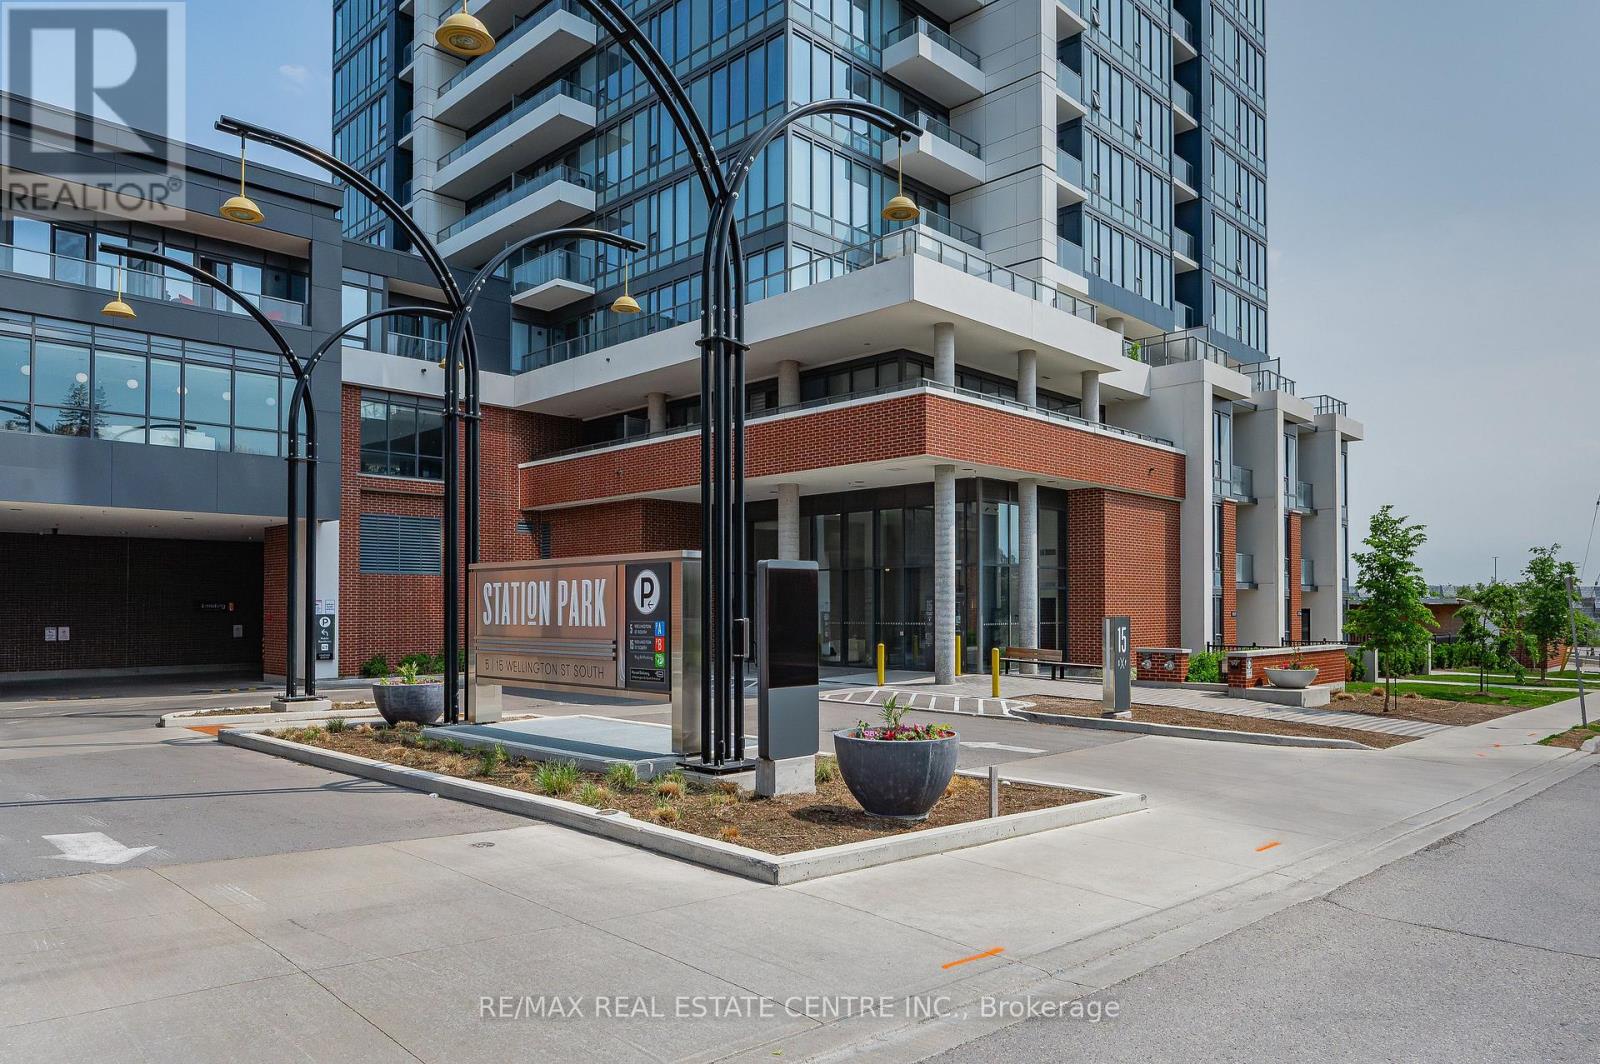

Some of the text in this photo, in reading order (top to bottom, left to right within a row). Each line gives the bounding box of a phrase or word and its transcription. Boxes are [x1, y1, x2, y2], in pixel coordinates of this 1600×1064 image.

[482, 578, 607, 627] STATION PARK
[640, 577, 655, 608] P
[1117, 626, 1127, 654] 15
[484, 658, 490, 670] 5
[496, 659, 504, 672] 15
[505, 660, 558, 676] WELLINGTON
[560, 663, 571, 677] ST
[573, 664, 605, 679] SOUTH
